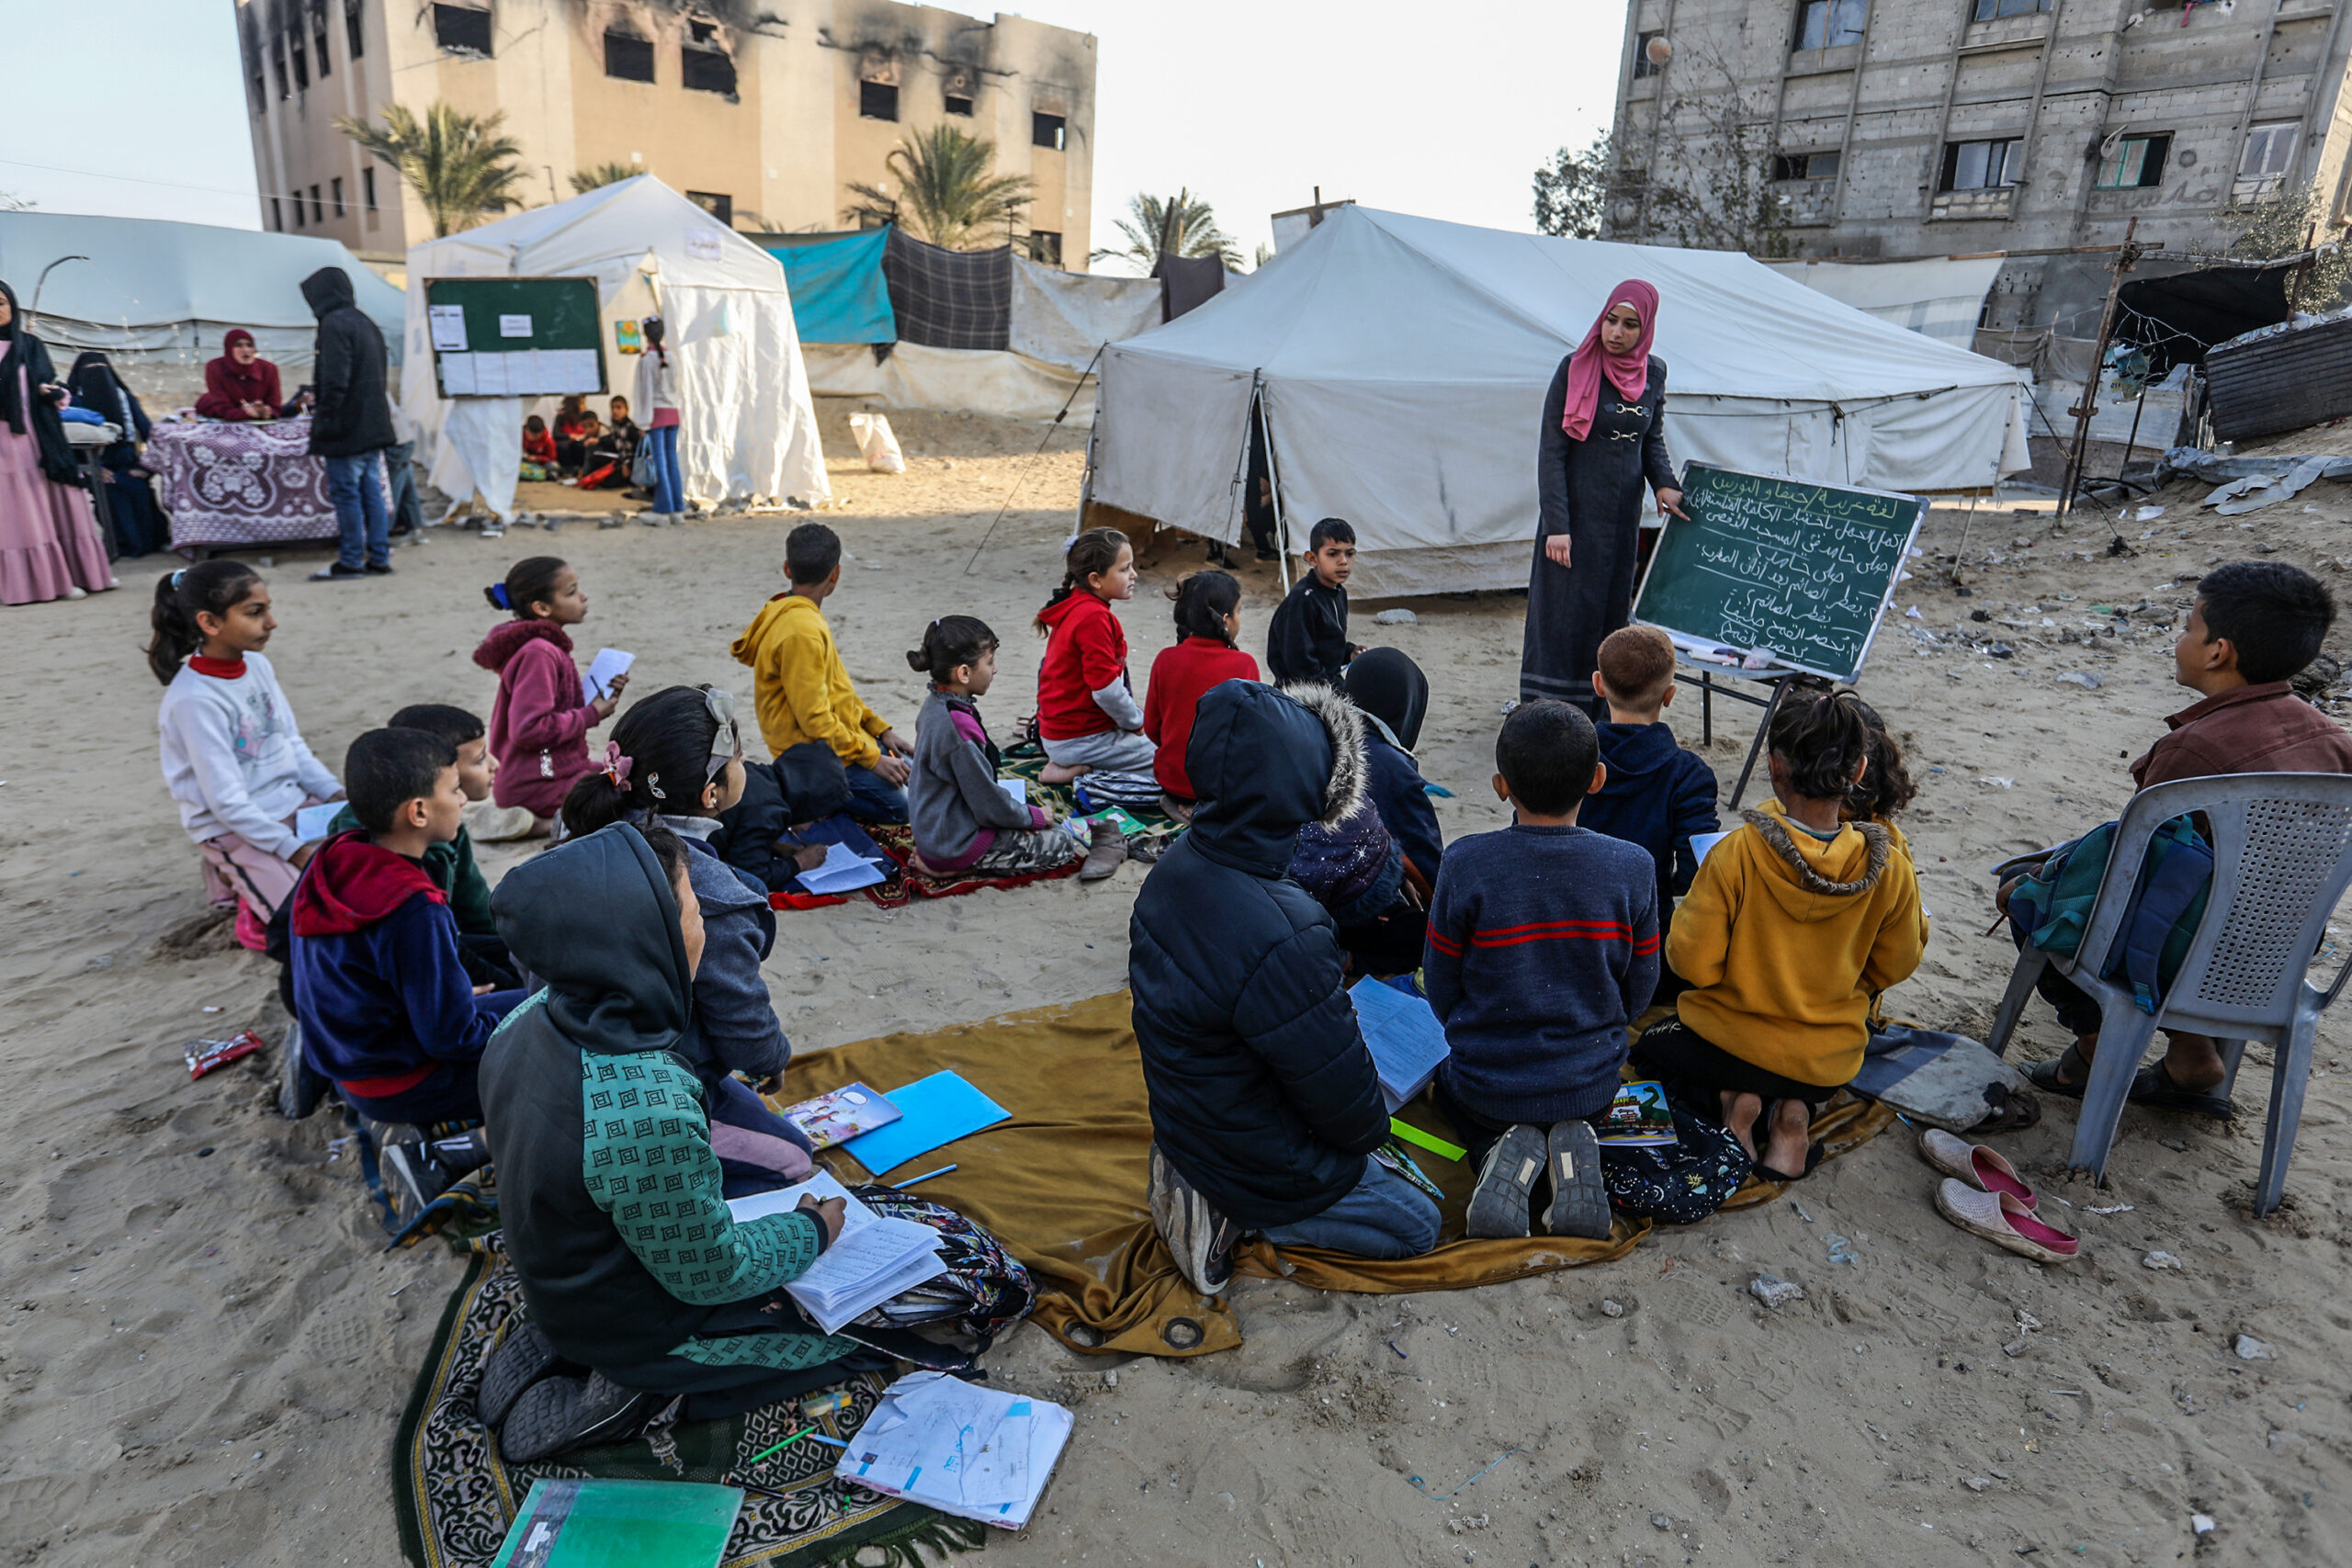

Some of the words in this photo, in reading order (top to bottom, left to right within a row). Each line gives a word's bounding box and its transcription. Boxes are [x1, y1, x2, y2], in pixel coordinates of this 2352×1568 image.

[1742, 498, 1782, 523] الكلمة
[1866, 497, 1898, 519] لغة
[1749, 525, 1801, 548] المسجد
[1835, 520, 1875, 545] الجمل
[1869, 530, 1908, 557] أكمل
[1802, 535, 1822, 557] في
[1818, 545, 1855, 564] حامد
[1767, 572, 1789, 589] بعد
[1785, 577, 1829, 603] الصائم
[1826, 584, 1862, 618] يفطر
[1791, 604, 1831, 629] يفطر
[1766, 620, 1805, 640] القمح
